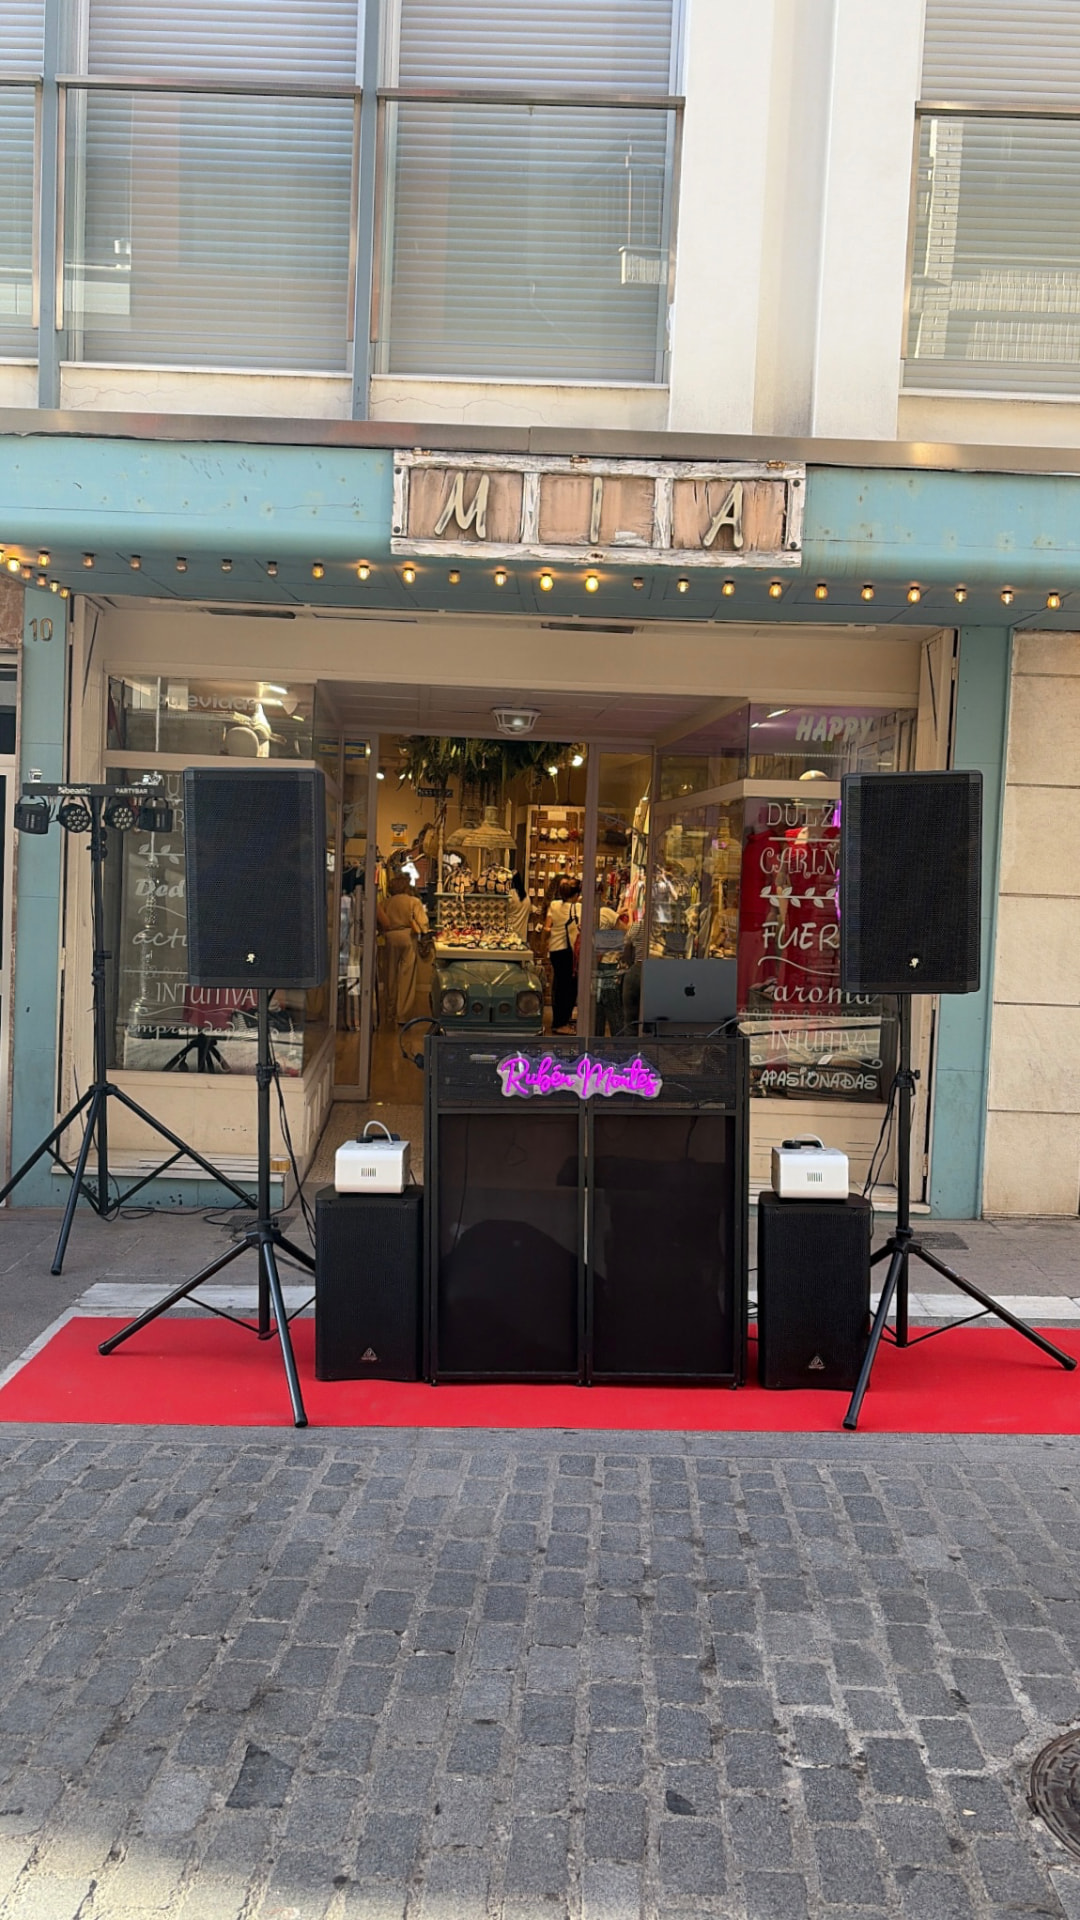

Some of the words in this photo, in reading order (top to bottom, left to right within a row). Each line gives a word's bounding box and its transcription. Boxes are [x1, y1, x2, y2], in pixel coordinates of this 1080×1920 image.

[29, 617, 53, 642] 10
[795, 714, 874, 742] HAPPY
[115, 787, 148, 795] PARTYBAR
[766, 803, 836, 827] DULZ
[760, 843, 840, 879] CARIÑ
[135, 879, 186, 898] Ded
[762, 922, 840, 951] FUER
[156, 982, 258, 1006] INTUITIVA
[769, 1029, 872, 1053] INTUITIVA
[501, 1056, 577, 1096] Rubén
[577, 1058, 659, 1097] Montes
